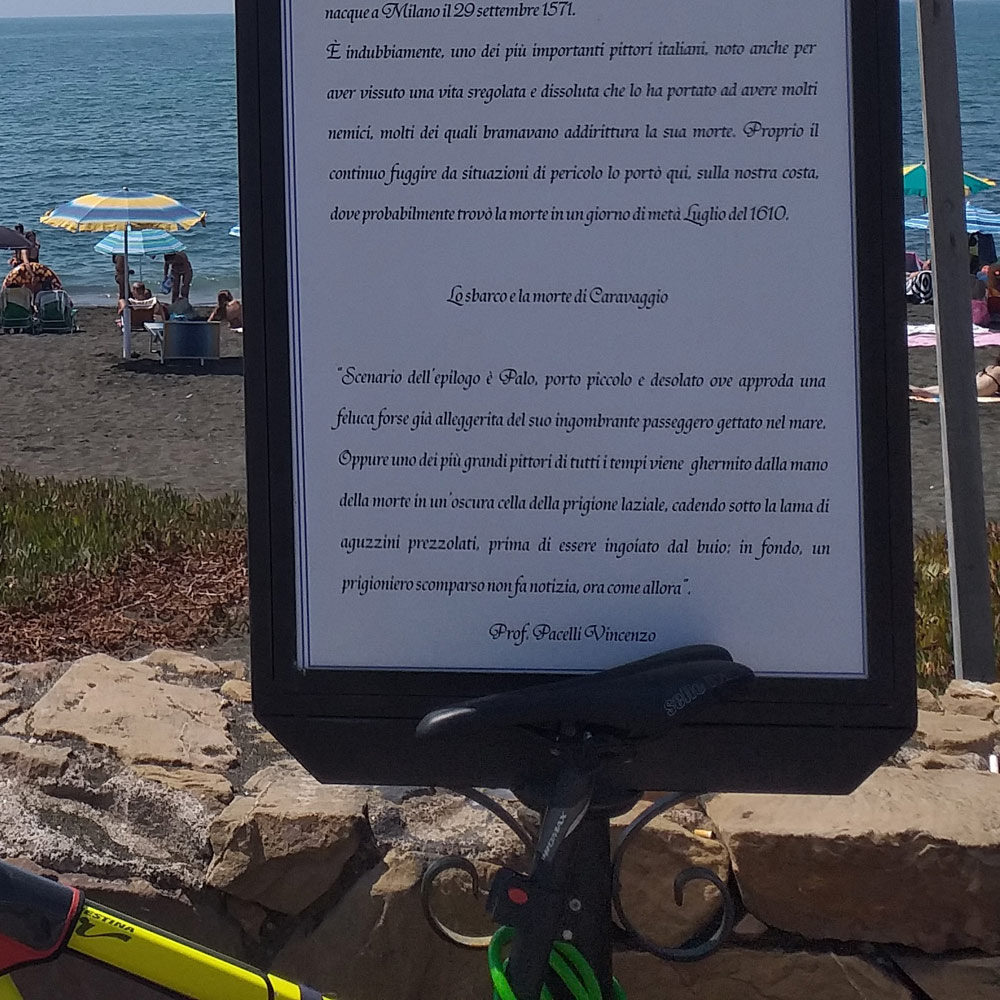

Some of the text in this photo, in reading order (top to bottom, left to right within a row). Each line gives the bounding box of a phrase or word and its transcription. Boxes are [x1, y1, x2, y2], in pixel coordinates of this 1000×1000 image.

[325, 1, 575, 23] nacque Milano il 29 settembre 1571.
[346, 44, 444, 59] indubbiamente,
[451, 48, 476, 58] uno
[481, 43, 500, 57] dei
[505, 43, 526, 62] più
[533, 42, 605, 61] importanti
[609, 42, 653, 61] pittori
[715, 44, 745, 55] noto
[750, 40, 789, 54] anche
[794, 44, 817, 58] per
[327, 81, 818, 104] aver vissuto una vita sregolata dissoluta che lo ha portato ad avere molti
[328, 121, 804, 143] nemici, molti dei quali bramavano addirittura la sua morte. Proprio
[329, 165, 385, 180] continuo
[384, 163, 437, 185] fuggire
[441, 166, 457, 179] da
[462, 165, 528, 179] situazioni
[533, 165, 546, 179] di
[550, 165, 603, 184] pericolo
[608, 165, 620, 179] lo
[624, 166, 662, 184] portò
[697, 165, 729, 179] sulla
[734, 168, 777, 179] nostra
[782, 168, 819, 179] costa,
[330, 204, 789, 226] dove probabilmente trovò morte un giorno di metà Luglio del 1610.
[446, 285, 668, 309] Lo sbarco morte di Caravaggio
[499, 369, 538, 386] Palo,
[545, 374, 581, 390] porto
[587, 371, 632, 390] piccolo
[651, 372, 704, 387] desolato
[710, 377, 733, 387] ove
[739, 373, 793, 392] approda
[800, 377, 825, 387] una
[331, 407, 825, 435] feluca forse già alleggerita del suo ingombrante passeggero gettato nel mare.
[339, 450, 828, 476] Oppure uno dei più grandi pittori tutti tempi viene ghermito dalla mano
[340, 493, 369, 507] della
[373, 496, 411, 508] morte
[498, 495, 526, 509] cella
[529, 496, 559, 510] della
[563, 496, 618, 516] prigione
[622, 496, 668, 512] laziale,
[672, 498, 726, 512] cadendo
[729, 501, 761, 512] sotto
[780, 498, 813, 512] lama
[816, 498, 830, 513] di
[341, 534, 400, 554] aguzzini
[489, 536, 529, 555] prima
[559, 542, 596, 552] essere
[605, 538, 659, 558] ingoiato
[667, 539, 688, 553] dal
[755, 537, 802, 560] fondo,
[813, 545, 830, 555] un
[342, 575, 413, 596] prigioniero
[416, 581, 485, 596] scomparso
[488, 582, 512, 592] non
[508, 575, 527, 598] fa
[530, 578, 579, 594] notizia,
[583, 583, 604, 593] ora
[607, 584, 640, 594] come
[489, 622, 656, 646] Prof. Pacelli Vincenzo
